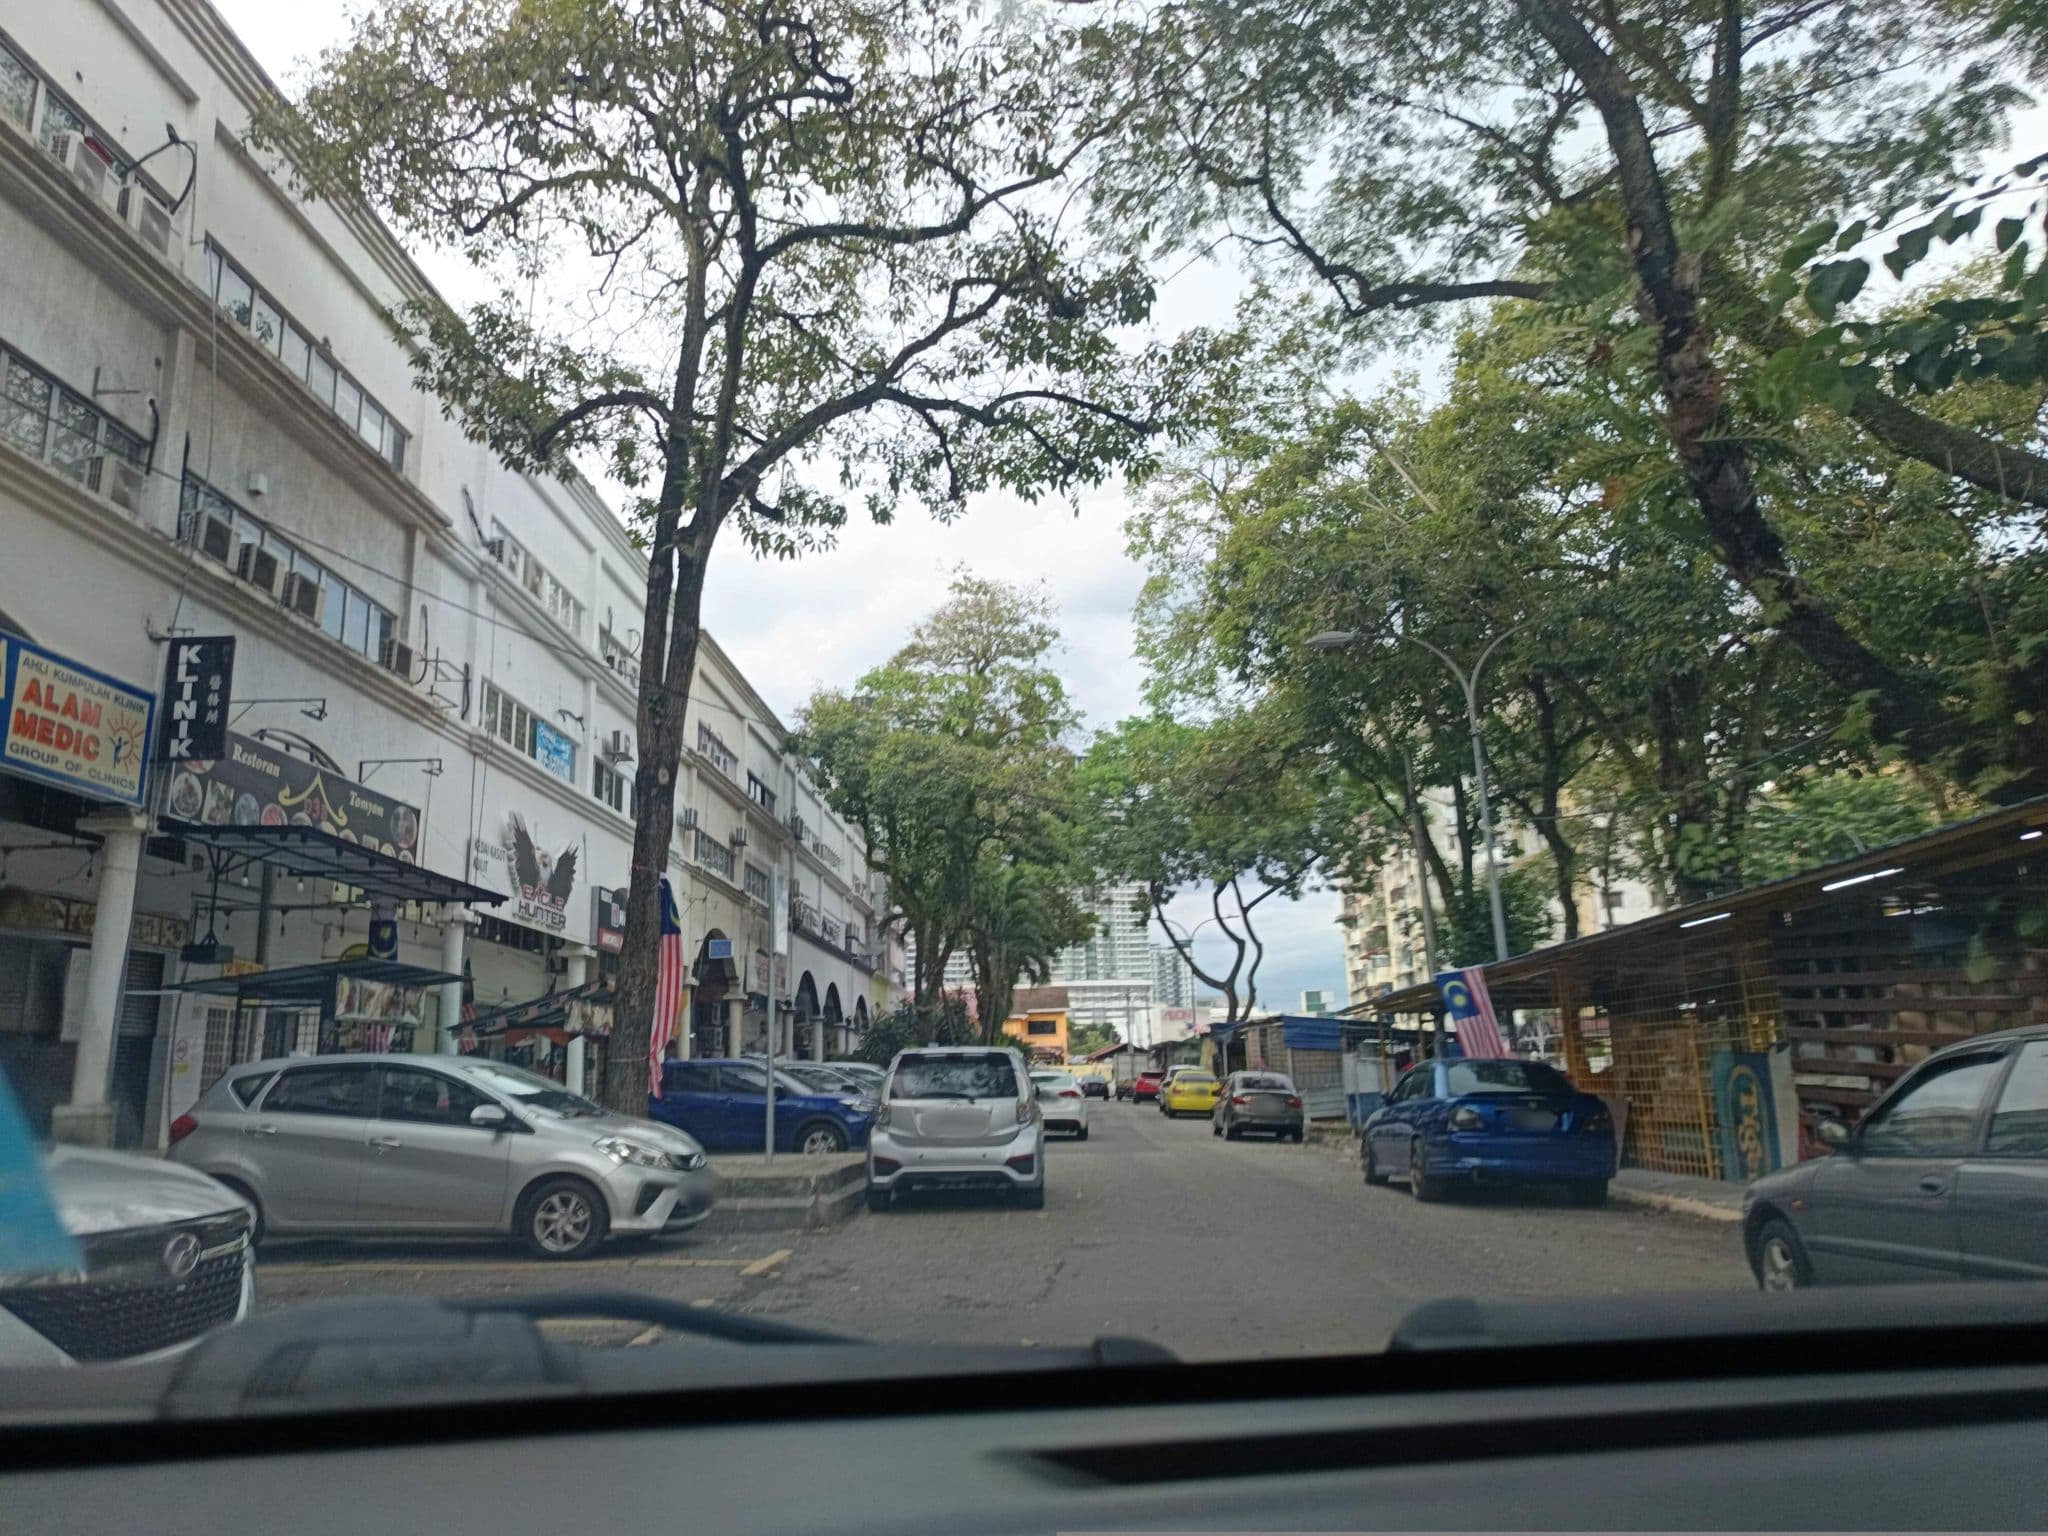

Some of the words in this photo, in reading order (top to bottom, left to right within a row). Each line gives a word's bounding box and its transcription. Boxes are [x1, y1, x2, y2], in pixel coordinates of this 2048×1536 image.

[22, 677, 102, 729] ALAM
[23, 656, 49, 675] AHLI
[53, 669, 111, 700] KUMPULAN
[114, 694, 146, 714] KLINIK
[169, 644, 202, 758] KLINIK
[12, 708, 101, 762] MEDIC
[233, 743, 280, 778] Restoran
[9, 742, 59, 765] GROUP
[65, 759, 83, 773] OF
[88, 768, 136, 791] CLINICS
[518, 900, 567, 930] HUNTER
